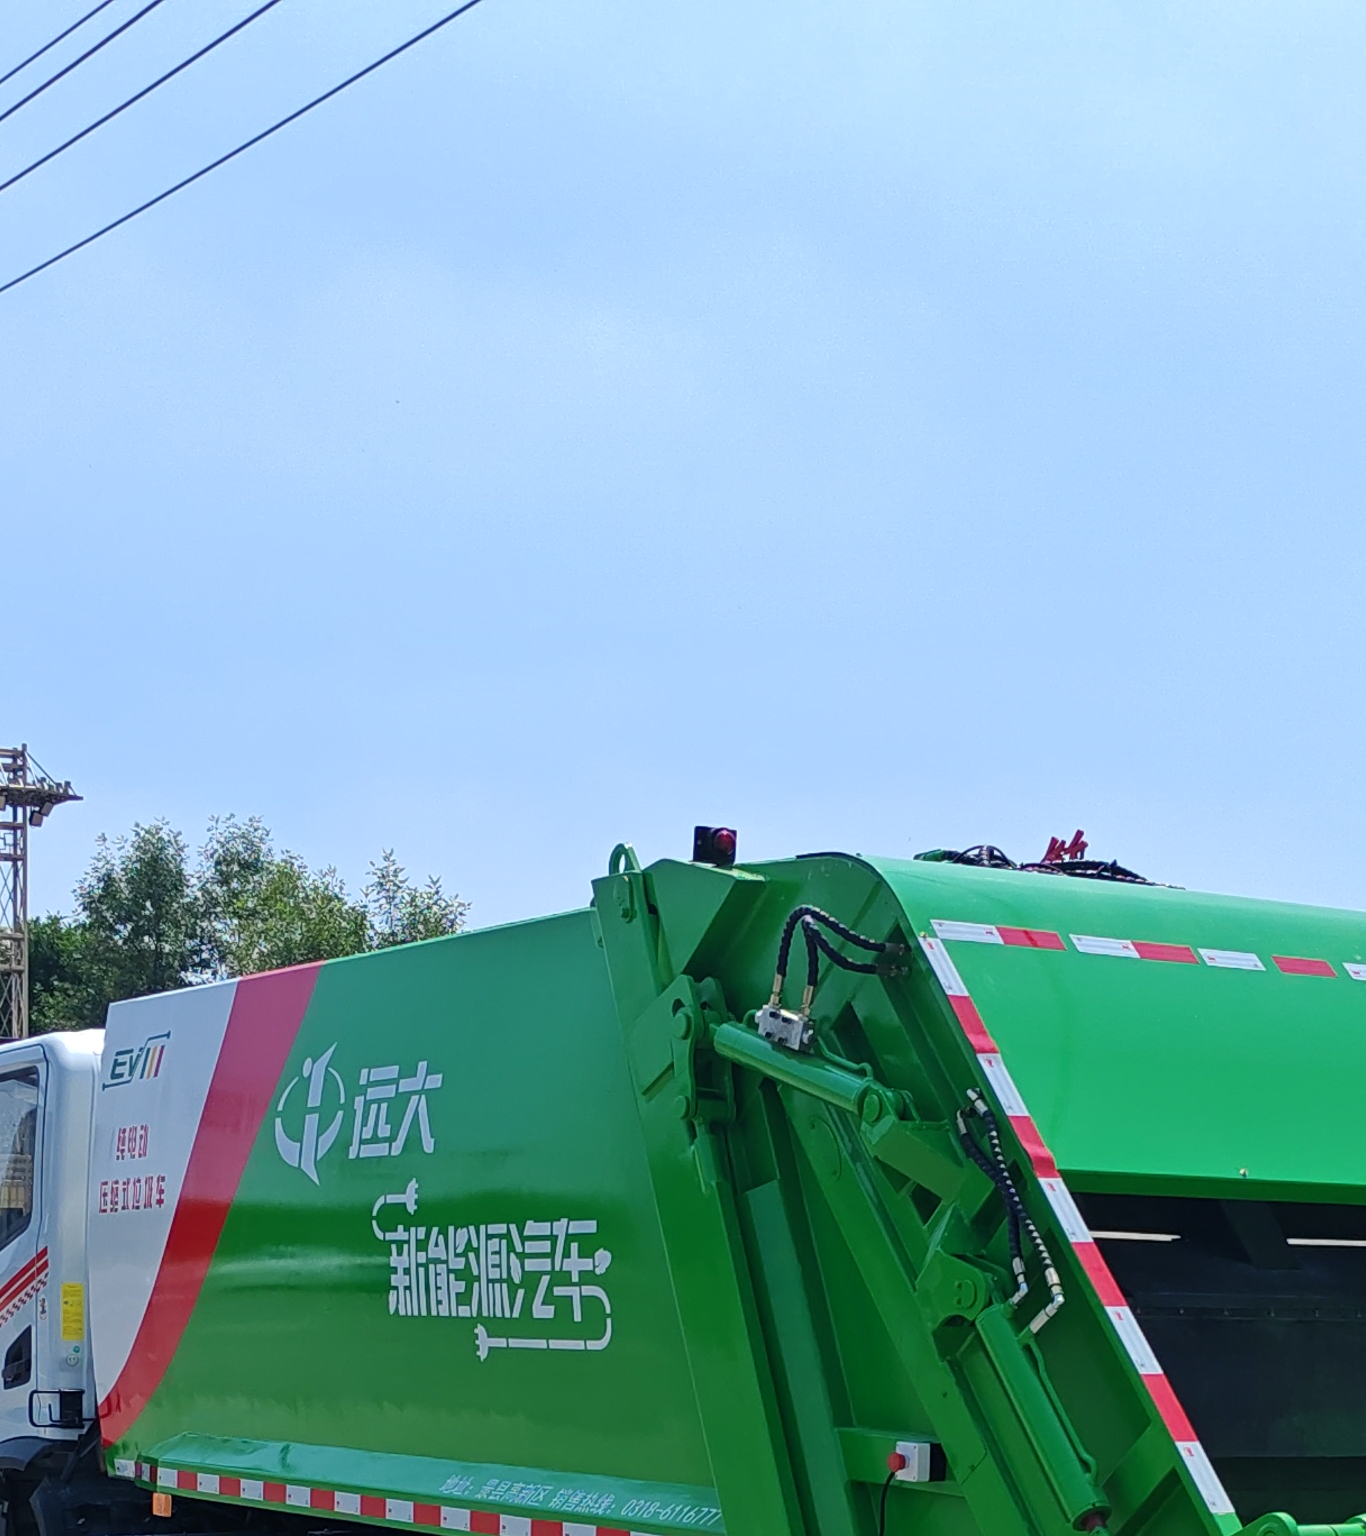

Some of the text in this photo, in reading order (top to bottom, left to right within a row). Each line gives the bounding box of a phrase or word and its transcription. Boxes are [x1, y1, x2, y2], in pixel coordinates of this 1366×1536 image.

[115, 1124, 150, 1161] 纯电动
[348, 1060, 443, 1160] 远大
[98, 1174, 166, 1214] 压缩式垃圾车
[388, 1218, 598, 1322] 新能源汽车
